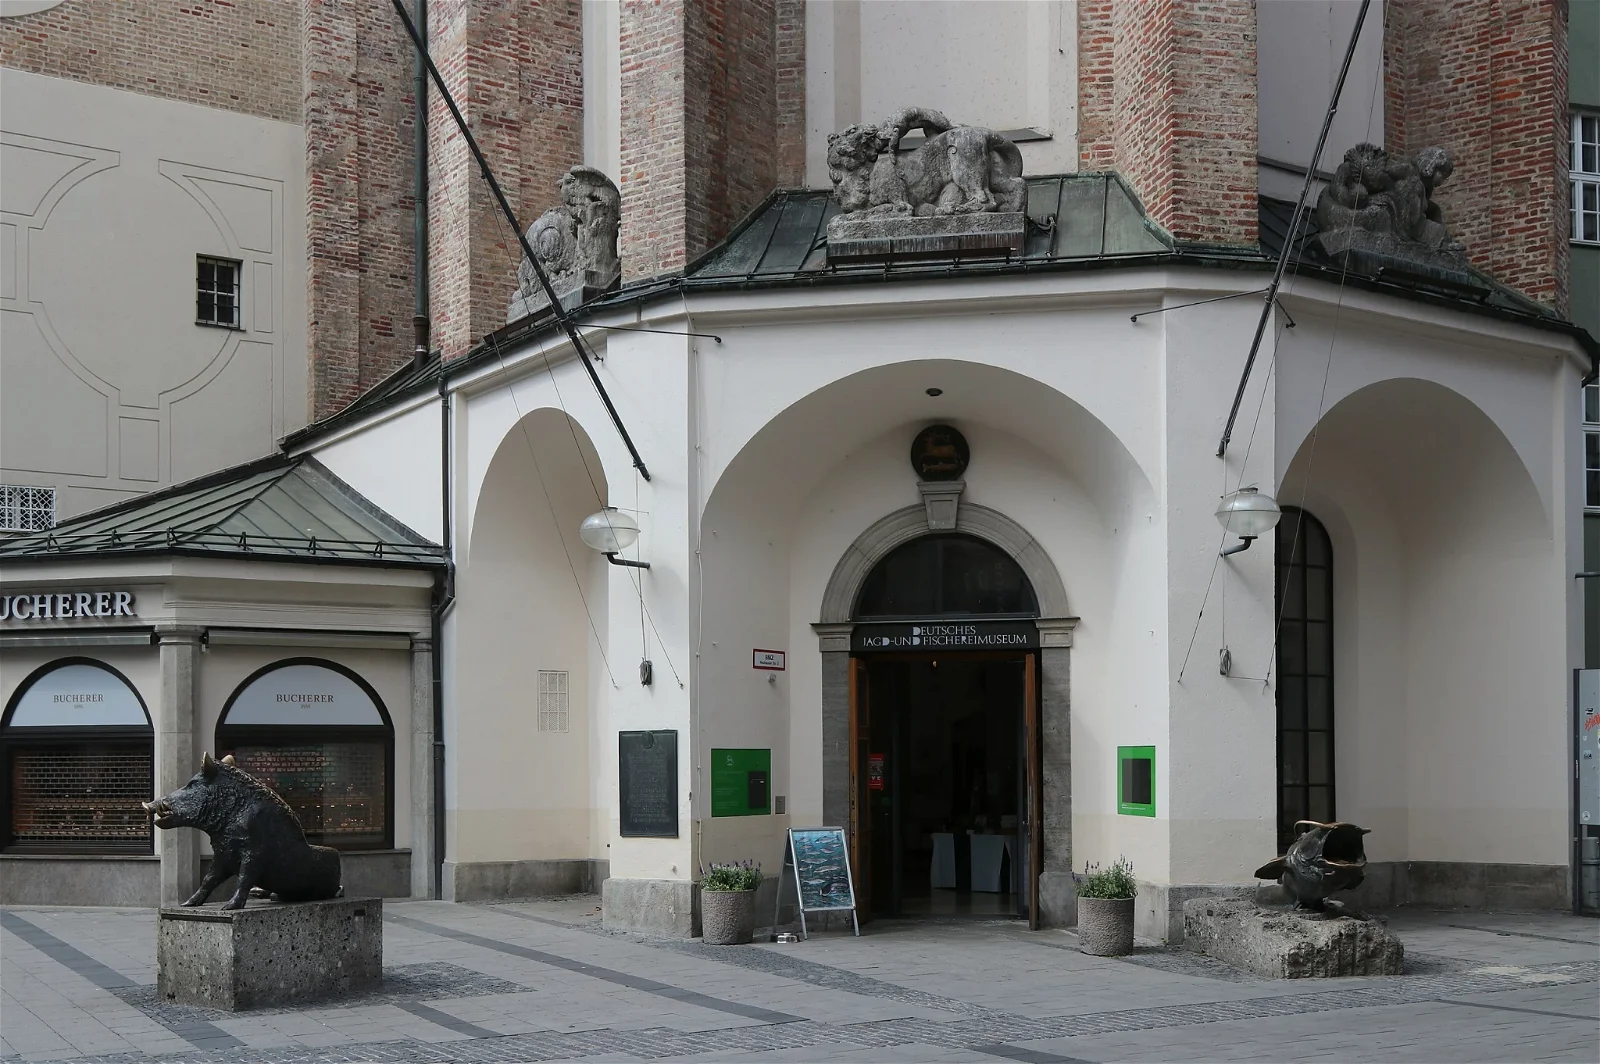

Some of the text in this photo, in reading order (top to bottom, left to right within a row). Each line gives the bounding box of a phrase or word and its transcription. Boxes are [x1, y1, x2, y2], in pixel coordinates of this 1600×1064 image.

[913, 625, 976, 636] DEUTSCHES
[923, 634, 1027, 646] FISCHEREIMUSEUM
[53, 694, 104, 703] BUCHERER
[276, 694, 334, 703] BUCHERER
